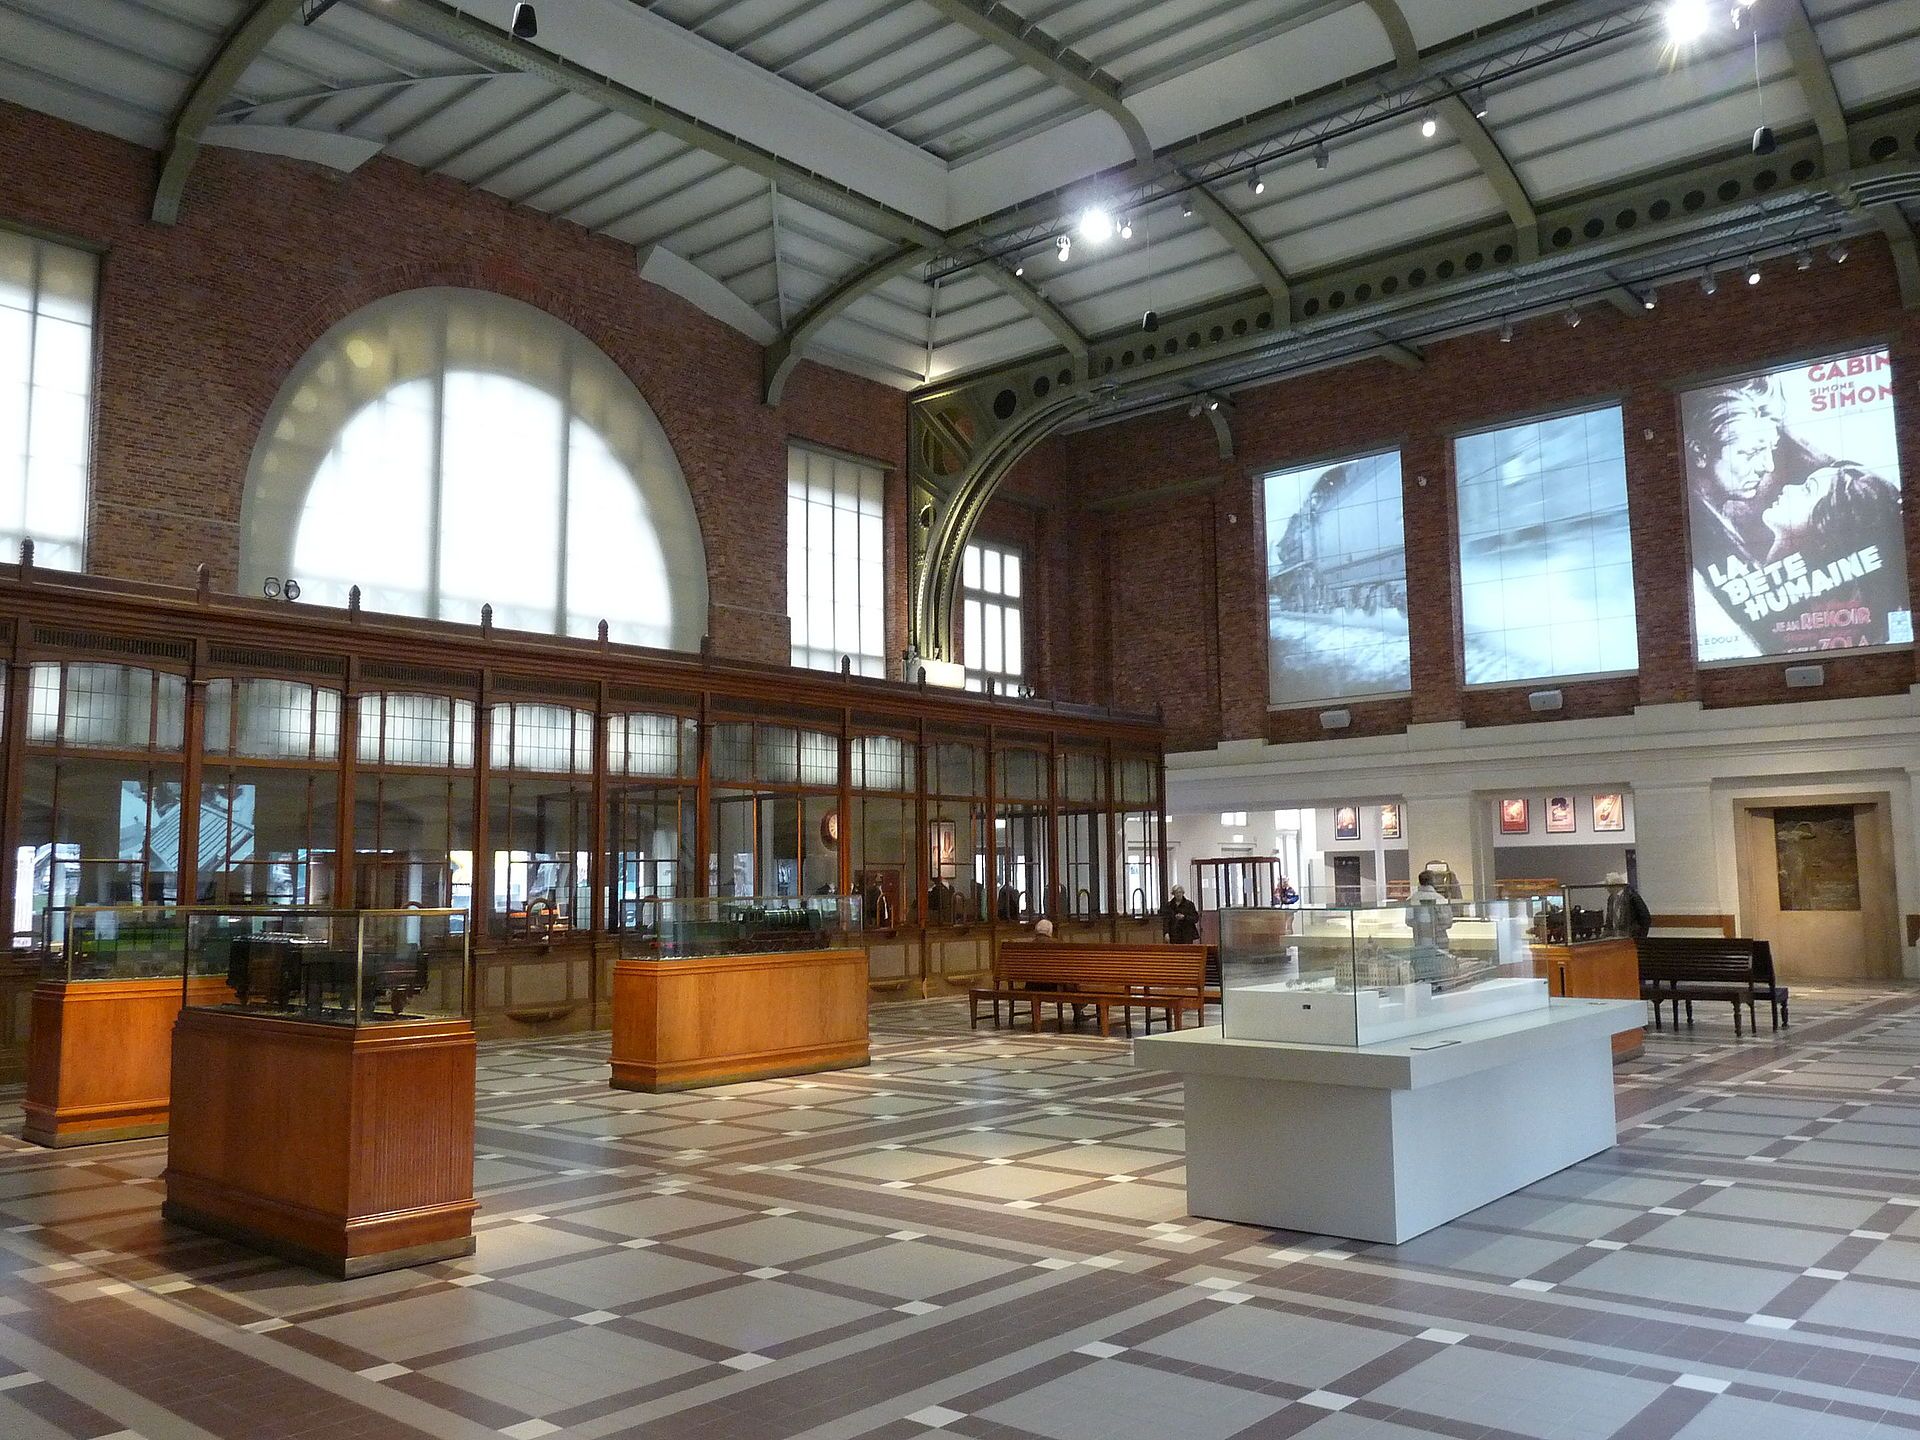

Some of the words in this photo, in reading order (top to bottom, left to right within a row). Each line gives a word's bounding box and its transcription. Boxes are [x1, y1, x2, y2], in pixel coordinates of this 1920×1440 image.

[1808, 354, 1890, 382] GABIN
[1809, 382, 1855, 396] SIMONE
[1811, 385, 1893, 412] SIMON
[1707, 555, 1751, 587] LA
[1721, 552, 1808, 606] BETE
[1744, 545, 1883, 622] HUMAINE
[1772, 621, 1800, 633] JEAN
[1800, 606, 1872, 630] RENOIR
